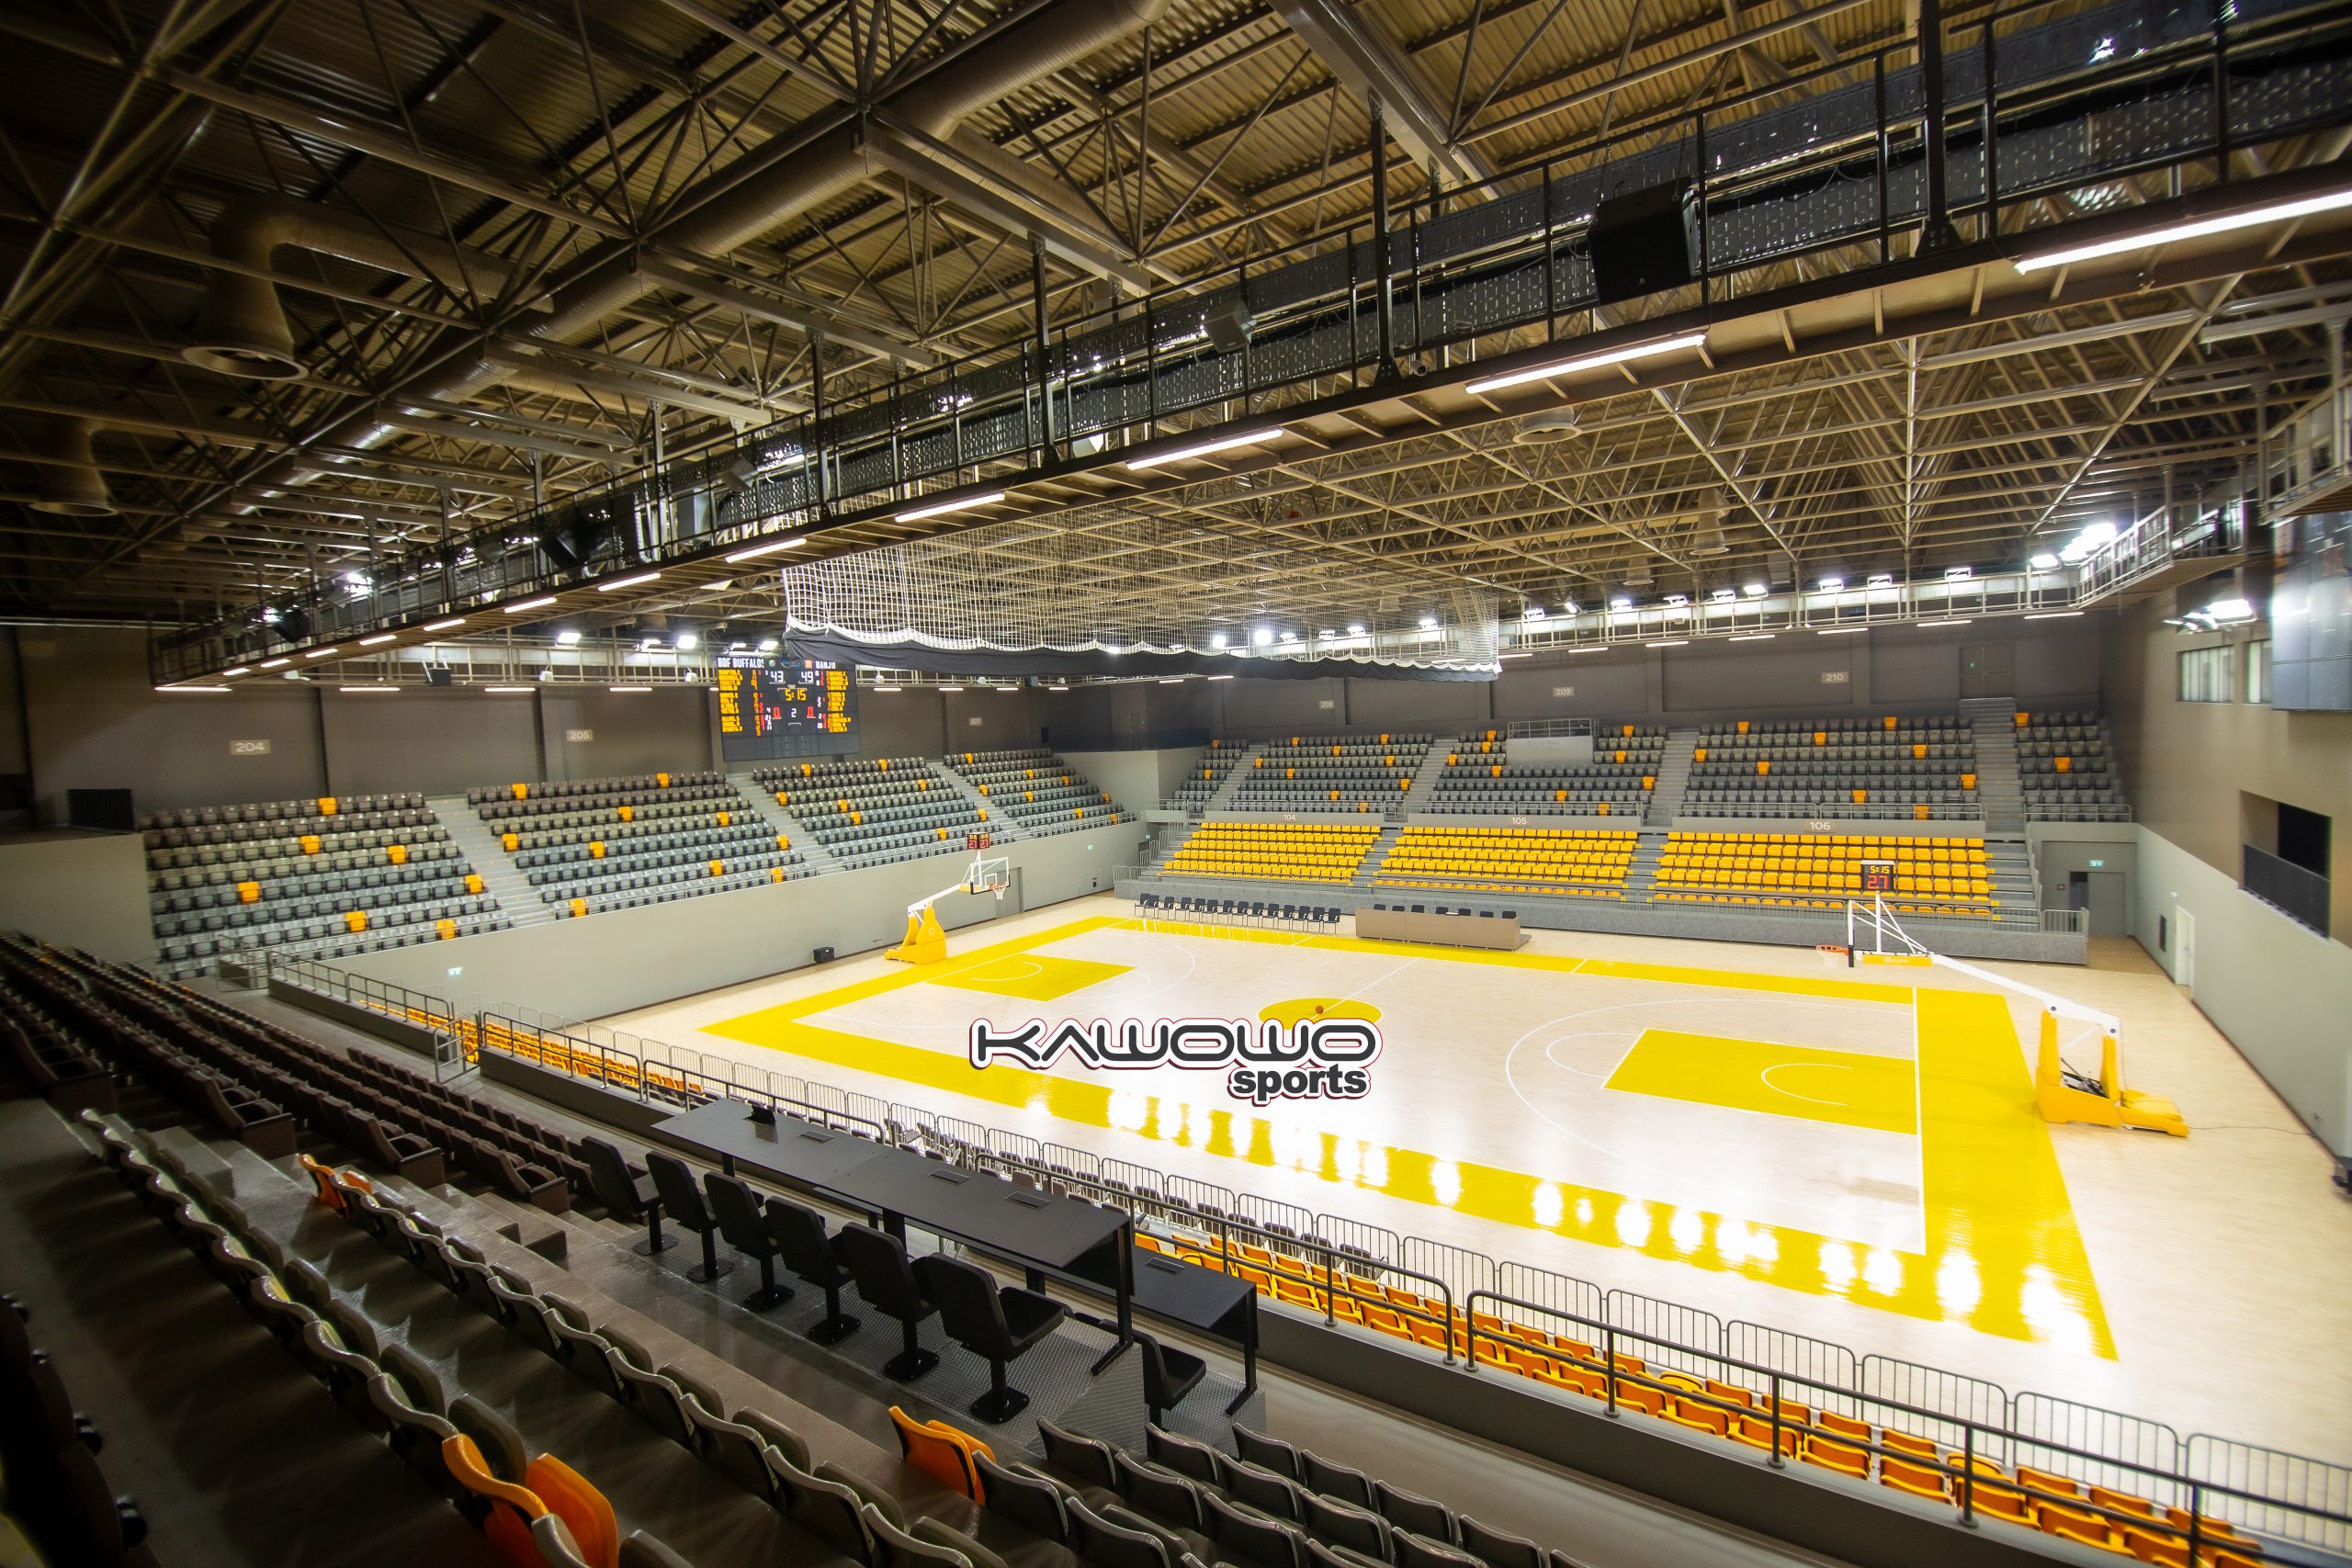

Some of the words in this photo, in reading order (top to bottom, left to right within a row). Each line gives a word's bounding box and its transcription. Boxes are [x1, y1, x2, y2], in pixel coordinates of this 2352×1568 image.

[770, 671, 785, 682] 43
[800, 671, 814, 682] 49
[1826, 673, 1844, 682] 210
[785, 689, 807, 702] 5:15
[773, 706, 780, 718] 0
[790, 707, 797, 718] 2
[807, 706, 814, 717] 0
[570, 730, 590, 740] 205
[234, 742, 266, 752] 204
[1511, 817, 1528, 825] 105
[1809, 821, 1831, 830] 106
[1870, 865, 1890, 874] 5:15
